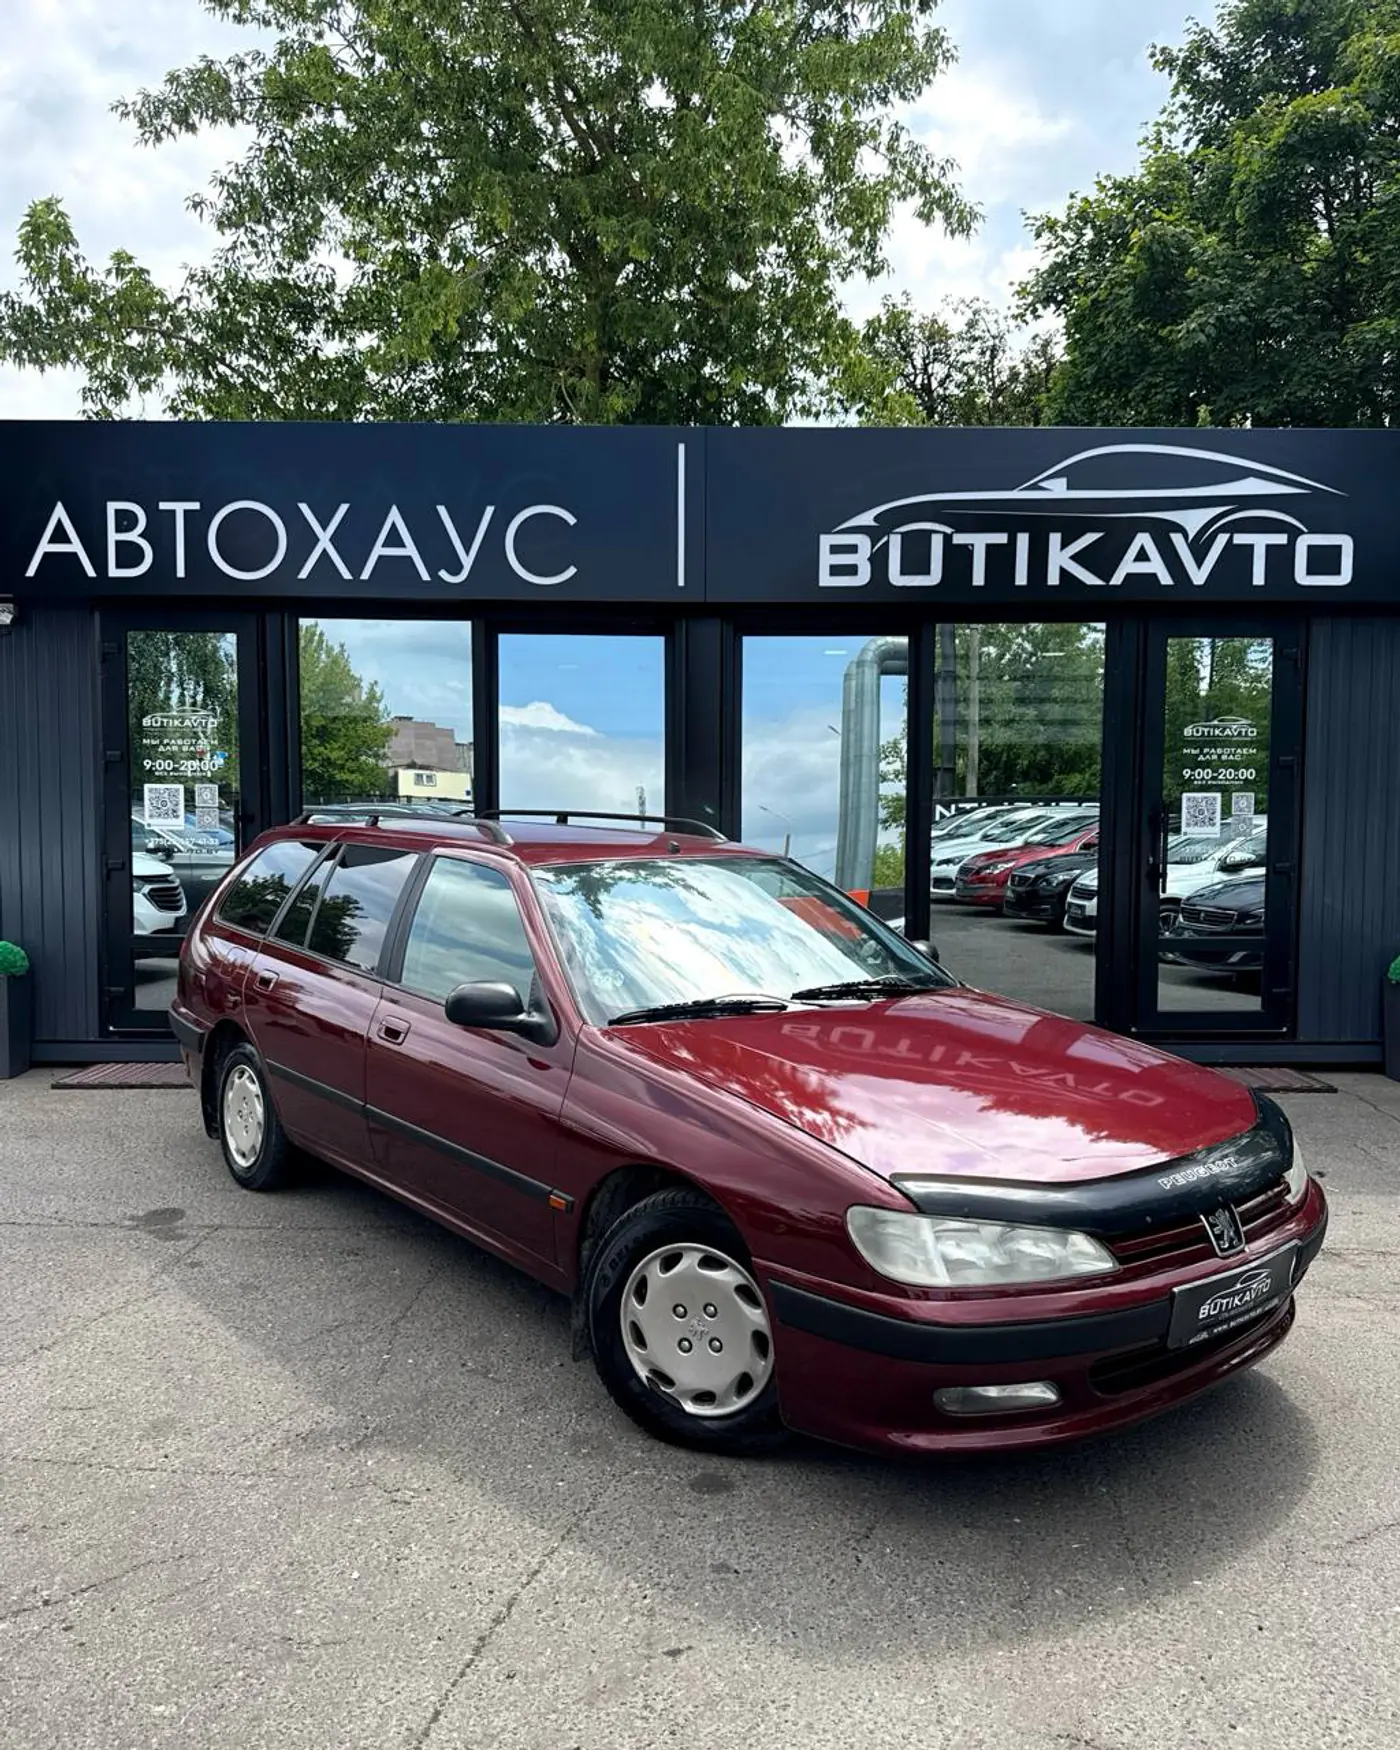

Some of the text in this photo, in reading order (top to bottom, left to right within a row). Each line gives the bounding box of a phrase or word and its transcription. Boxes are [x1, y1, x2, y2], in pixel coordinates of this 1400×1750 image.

[25, 500, 579, 585] АВТОХАУС
[818, 532, 1354, 587] BUTIKAVTO
[142, 717, 218, 728] BUTIKAVTO
[1183, 727, 1258, 737] BUTIKAVTO
[143, 759, 218, 771] 9:00-20:00
[1182, 768, 1256, 780] 9:00-20:00
[1157, 1157, 1239, 1191] PEUGEOT
[1197, 1278, 1272, 1321] BUTIKAVTO
